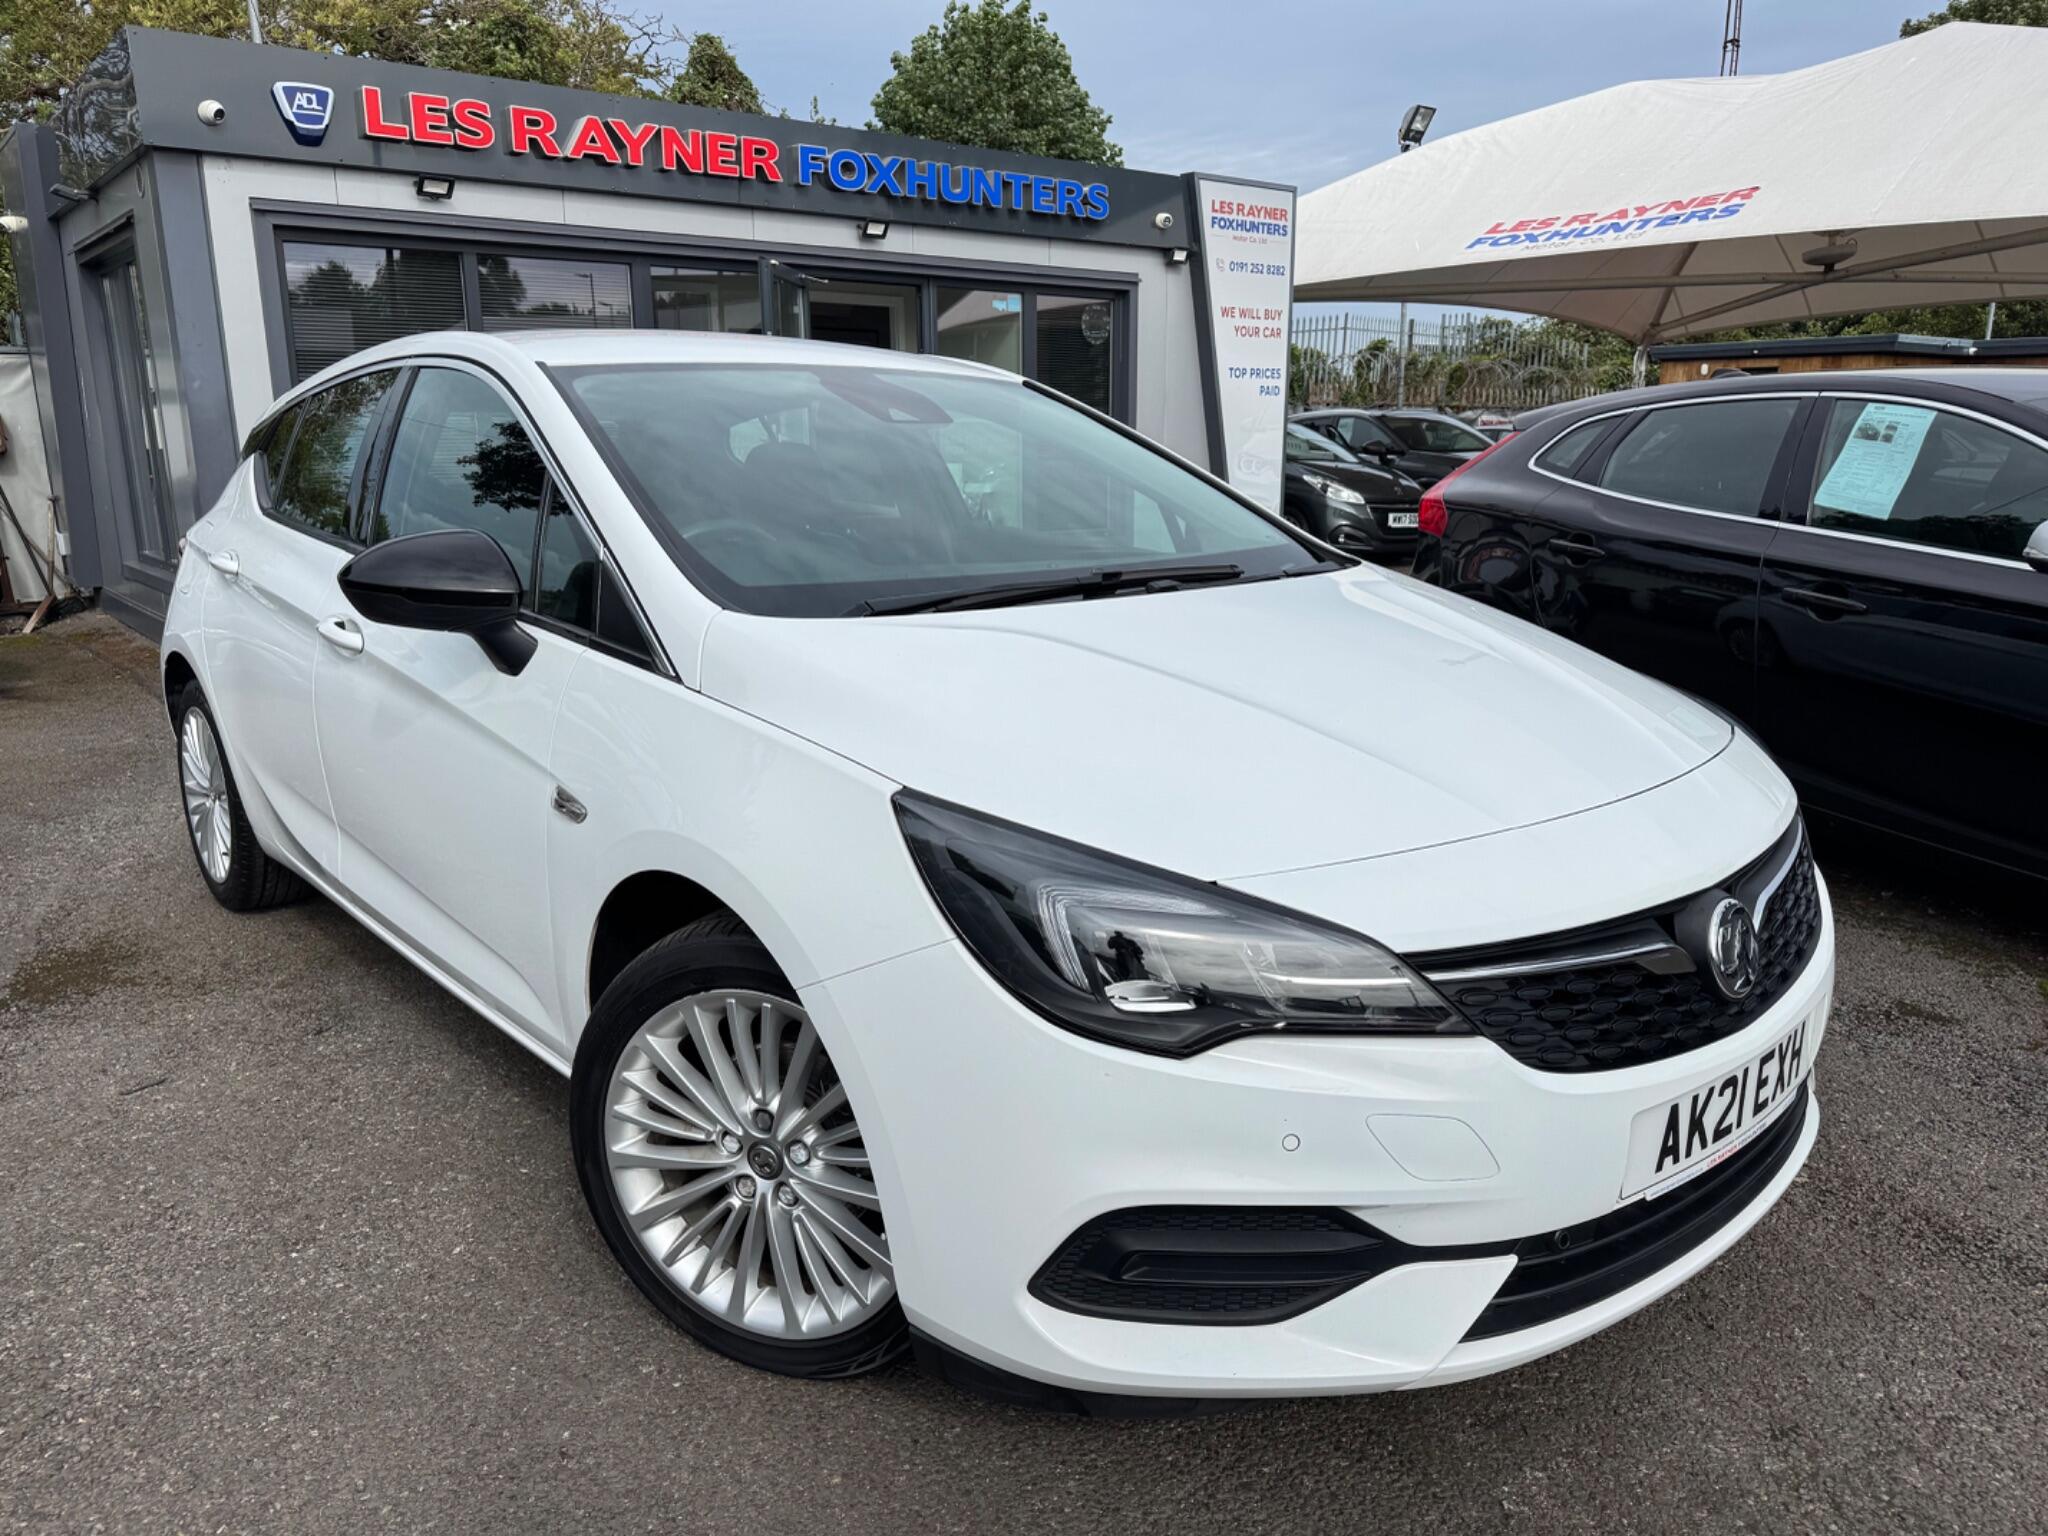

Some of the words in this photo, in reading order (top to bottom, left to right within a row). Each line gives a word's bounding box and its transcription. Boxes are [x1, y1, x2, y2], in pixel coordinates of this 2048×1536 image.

[359, 85, 495, 149] LES
[509, 105, 783, 183] RAYNER
[798, 143, 1110, 221] FOXHUNTERS
[1211, 199, 1233, 215] LES
[1236, 203, 1288, 222] RAYNER
[1561, 186, 1761, 228] RAYNER
[1211, 216, 1288, 237] FOXHUNTERS
[1465, 203, 1746, 250] FOXHUNTERS
[1484, 215, 1562, 235] LES
[1229, 261, 1248, 273] 0191
[1250, 262, 1264, 274] 252
[1266, 264, 1286, 276] 8282
[1221, 306, 1236, 318] WE
[1239, 307, 1262, 320] WILL
[1264, 308, 1283, 321] BUY
[1234, 325, 1260, 338] YOUR
[1263, 326, 1282, 339] CAR
[1229, 367, 1247, 379] TOP
[1250, 367, 1281, 379] PRICES
[1259, 385, 1280, 396] PAID
[1655, 1065, 1749, 1174] AK21
[1753, 1020, 1806, 1118] EXH
